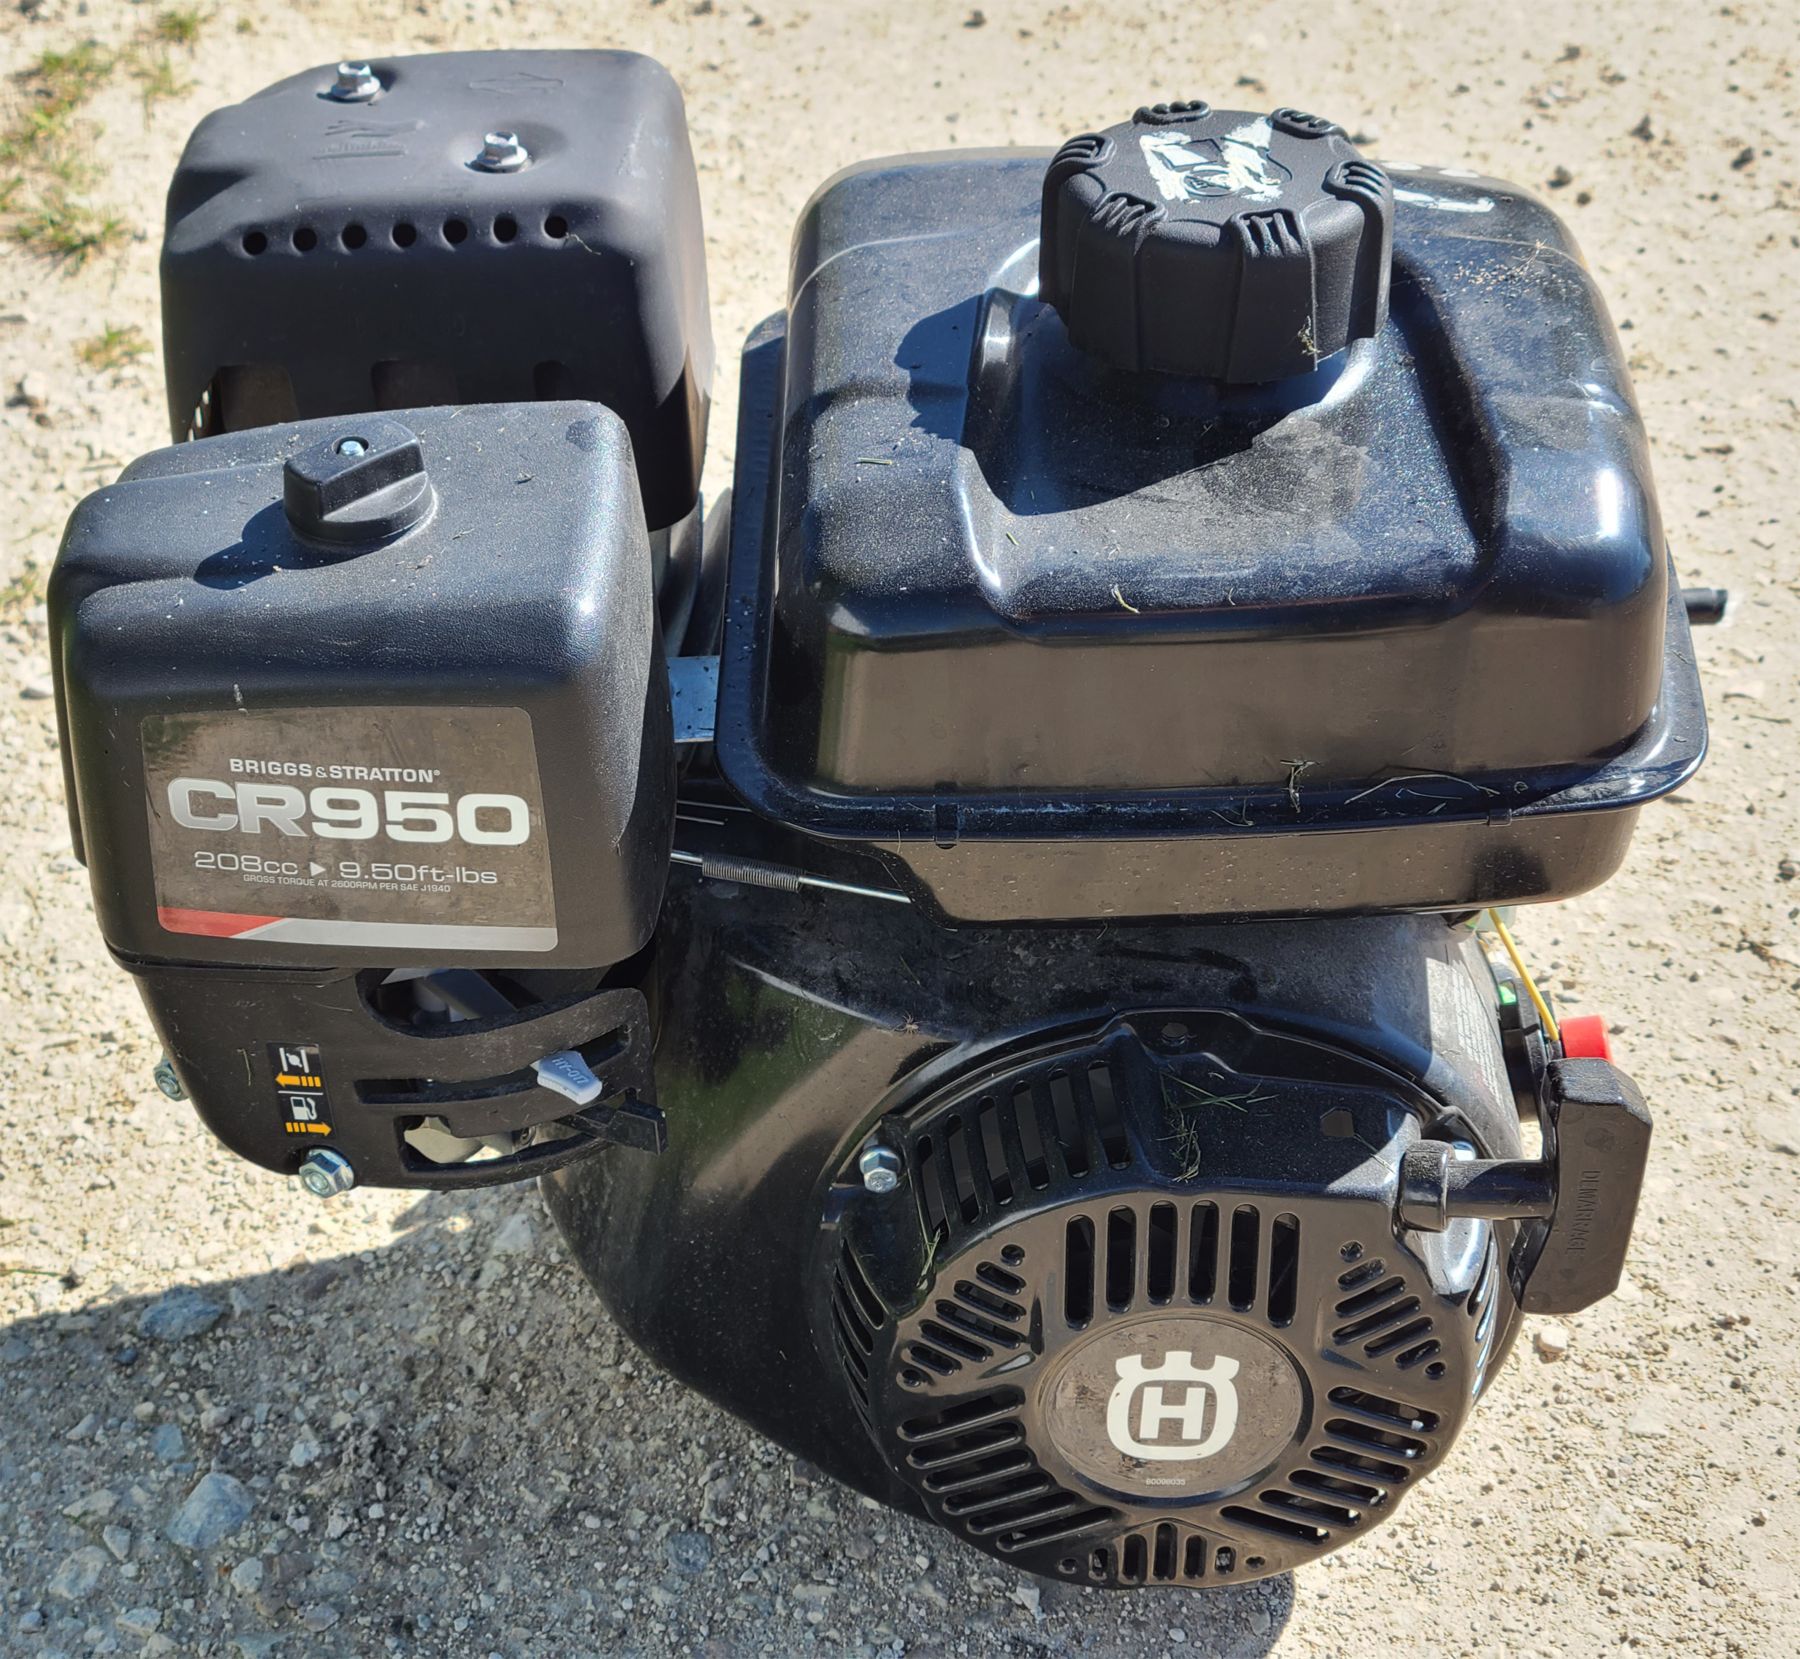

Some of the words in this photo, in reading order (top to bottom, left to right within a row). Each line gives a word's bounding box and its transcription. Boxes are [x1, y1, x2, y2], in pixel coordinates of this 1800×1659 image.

[167, 777, 530, 845] CR950
[194, 851, 299, 875] 208cc
[339, 861, 498, 884] 9.50ft-lbs
[243, 874, 276, 884] GROSS
[277, 876, 316, 887] TORQUE
[317, 879, 330, 888] AT
[331, 880, 378, 890] 2600RPM
[379, 882, 399, 891] PER
[400, 883, 419, 892] SAE
[420, 884, 451, 893] J1940
